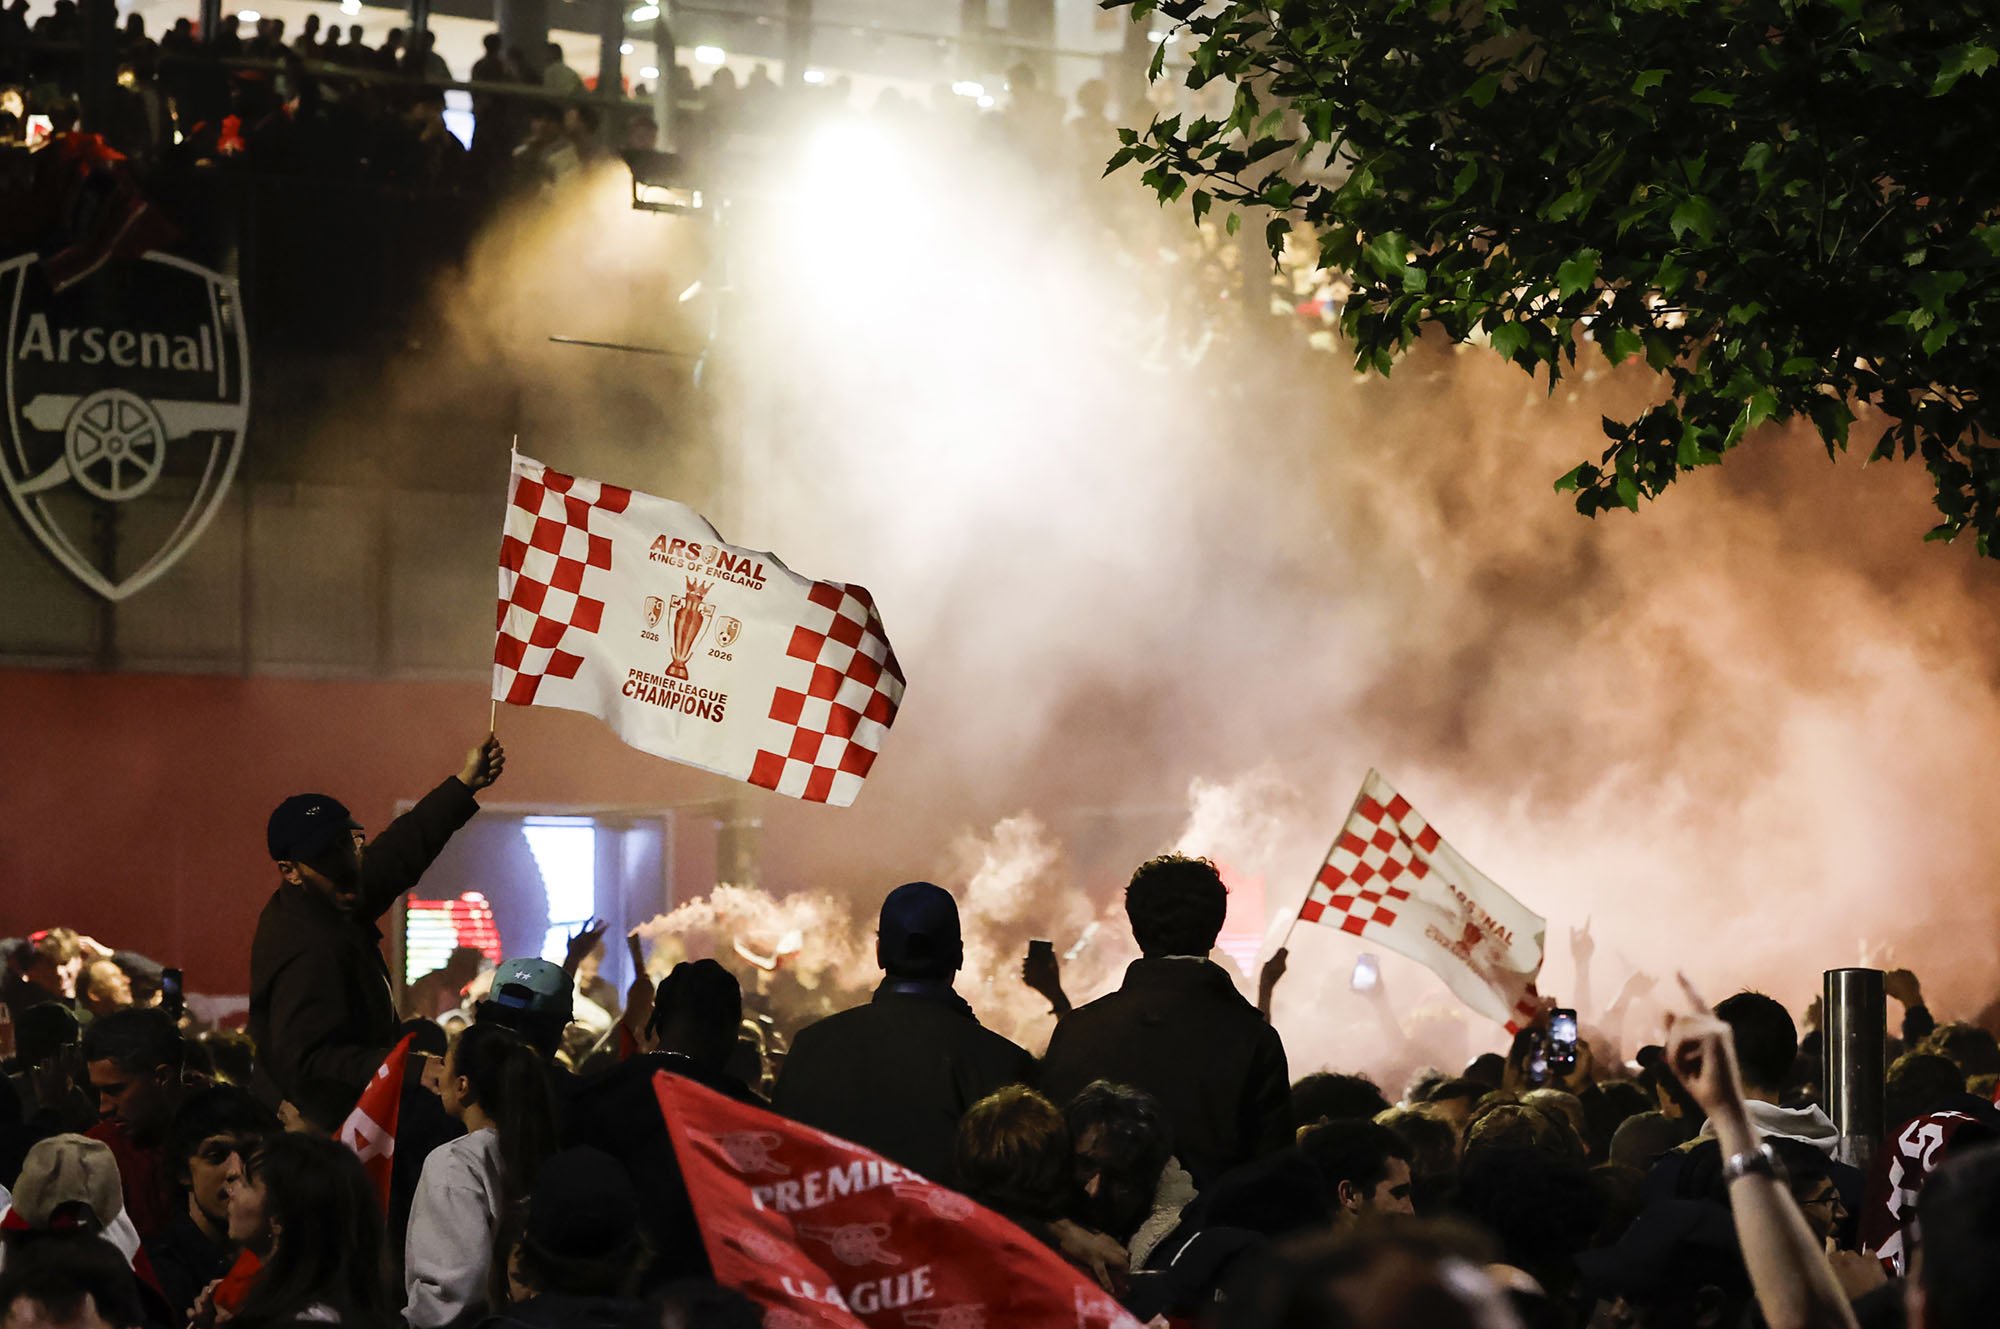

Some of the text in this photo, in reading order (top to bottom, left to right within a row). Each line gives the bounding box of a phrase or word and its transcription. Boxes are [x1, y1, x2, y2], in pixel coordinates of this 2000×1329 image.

[18, 313, 214, 372] Arsenal
[649, 551, 763, 591] KINGS OF ENGLAND
[650, 534, 767, 582] ARSNAL
[640, 630, 660, 642] 2026
[707, 648, 733, 662] 2026
[622, 679, 726, 723] CHAMPIONS
[628, 668, 728, 705] PREMIER LEAGUE
